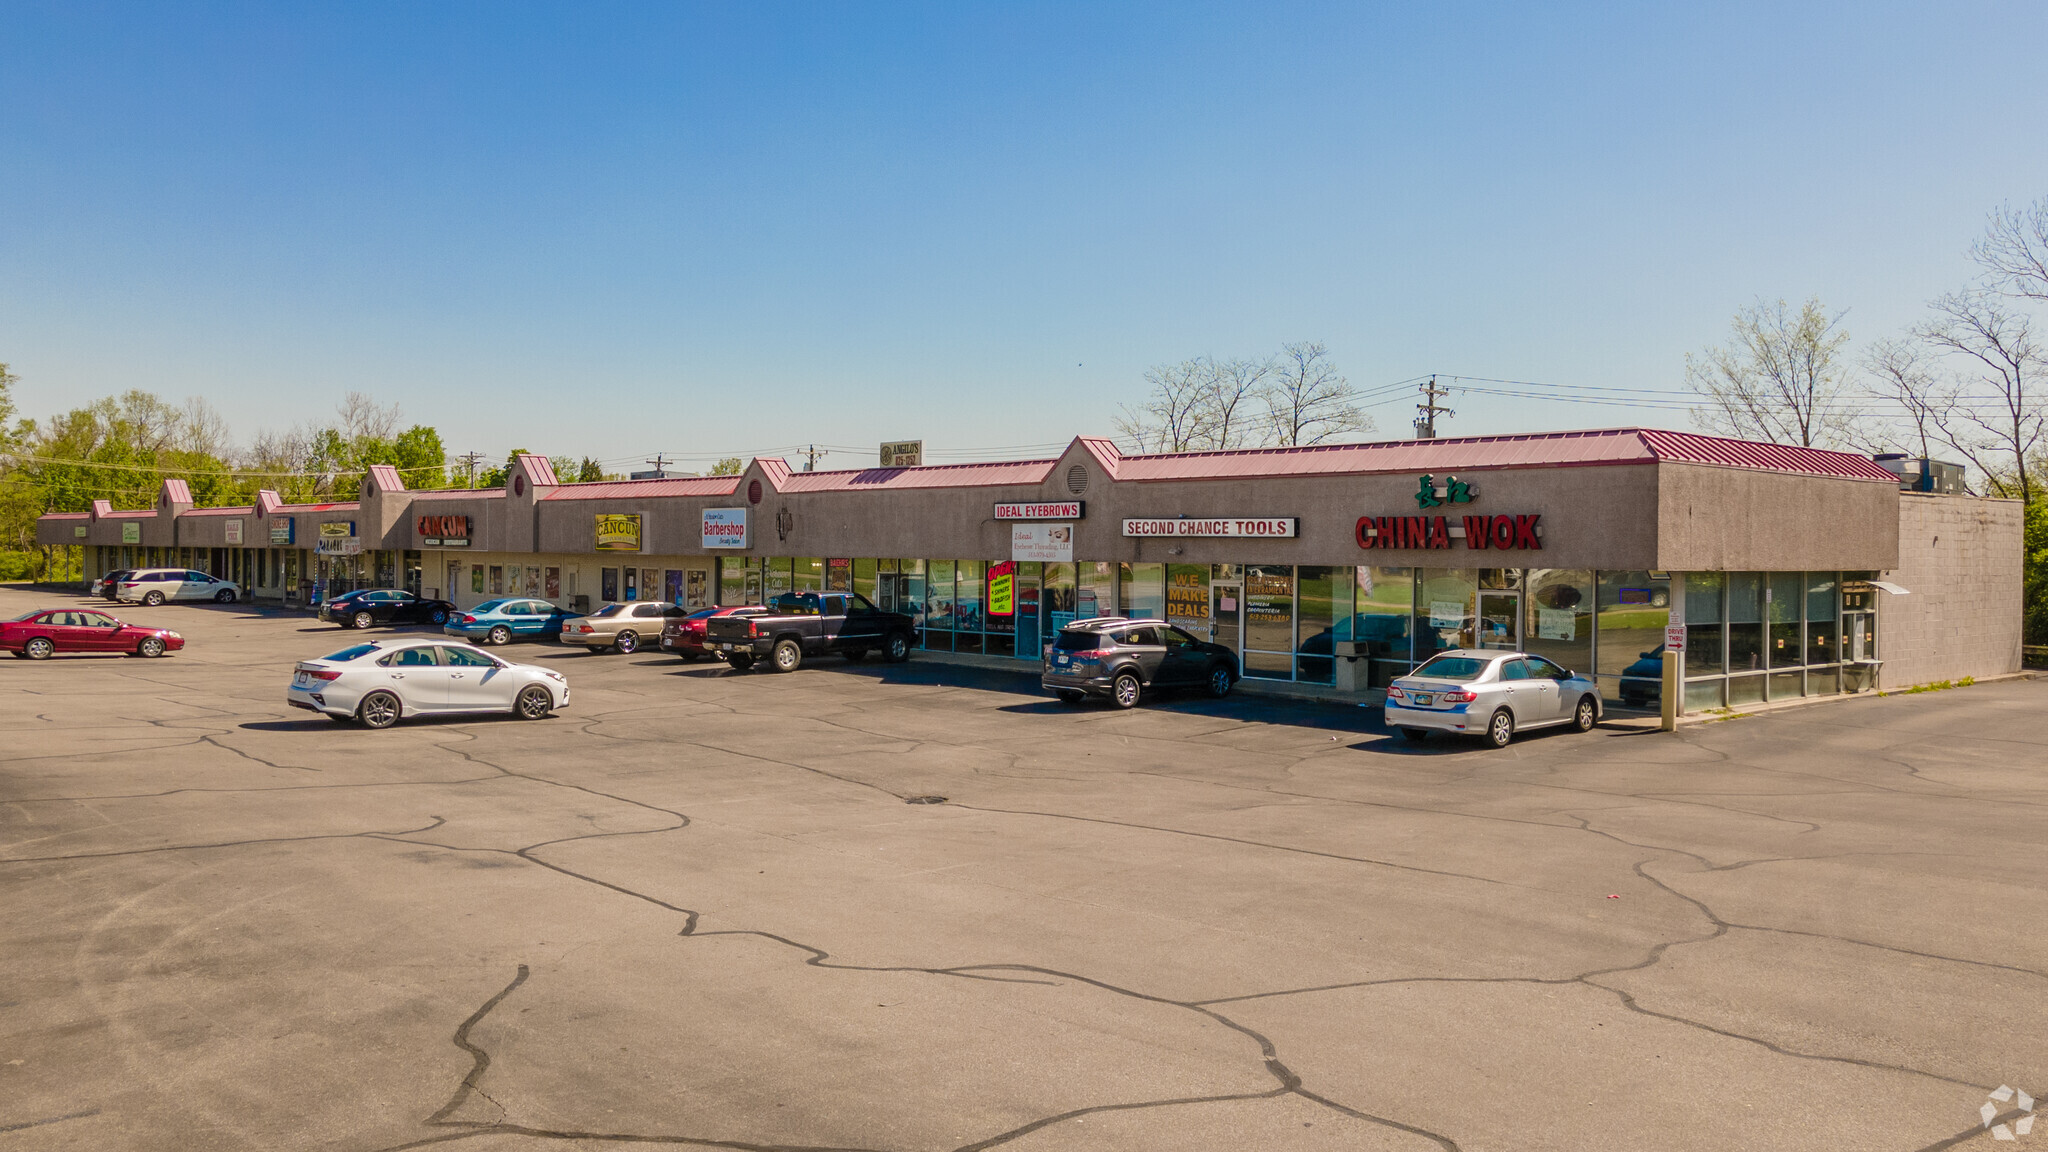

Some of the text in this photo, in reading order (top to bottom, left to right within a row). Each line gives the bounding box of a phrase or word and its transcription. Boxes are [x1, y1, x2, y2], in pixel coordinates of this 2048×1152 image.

[892, 443, 918, 454] ANGILO'S
[997, 504, 1078, 518] IDEAL EYEBROWS
[417, 516, 468, 536] CANCUN
[598, 521, 638, 536] CANCUN
[704, 520, 744, 539] Barbershop
[1128, 521, 1287, 534] SECOND CHANCE TOOLS
[1356, 514, 1541, 550] CHINA WOK
[1014, 532, 1032, 540] Ideal
[988, 561, 1016, 580] OPEN!
[1176, 574, 1199, 588] WE
[1168, 588, 1208, 602] MAKE
[1168, 603, 1210, 618] DEALS
